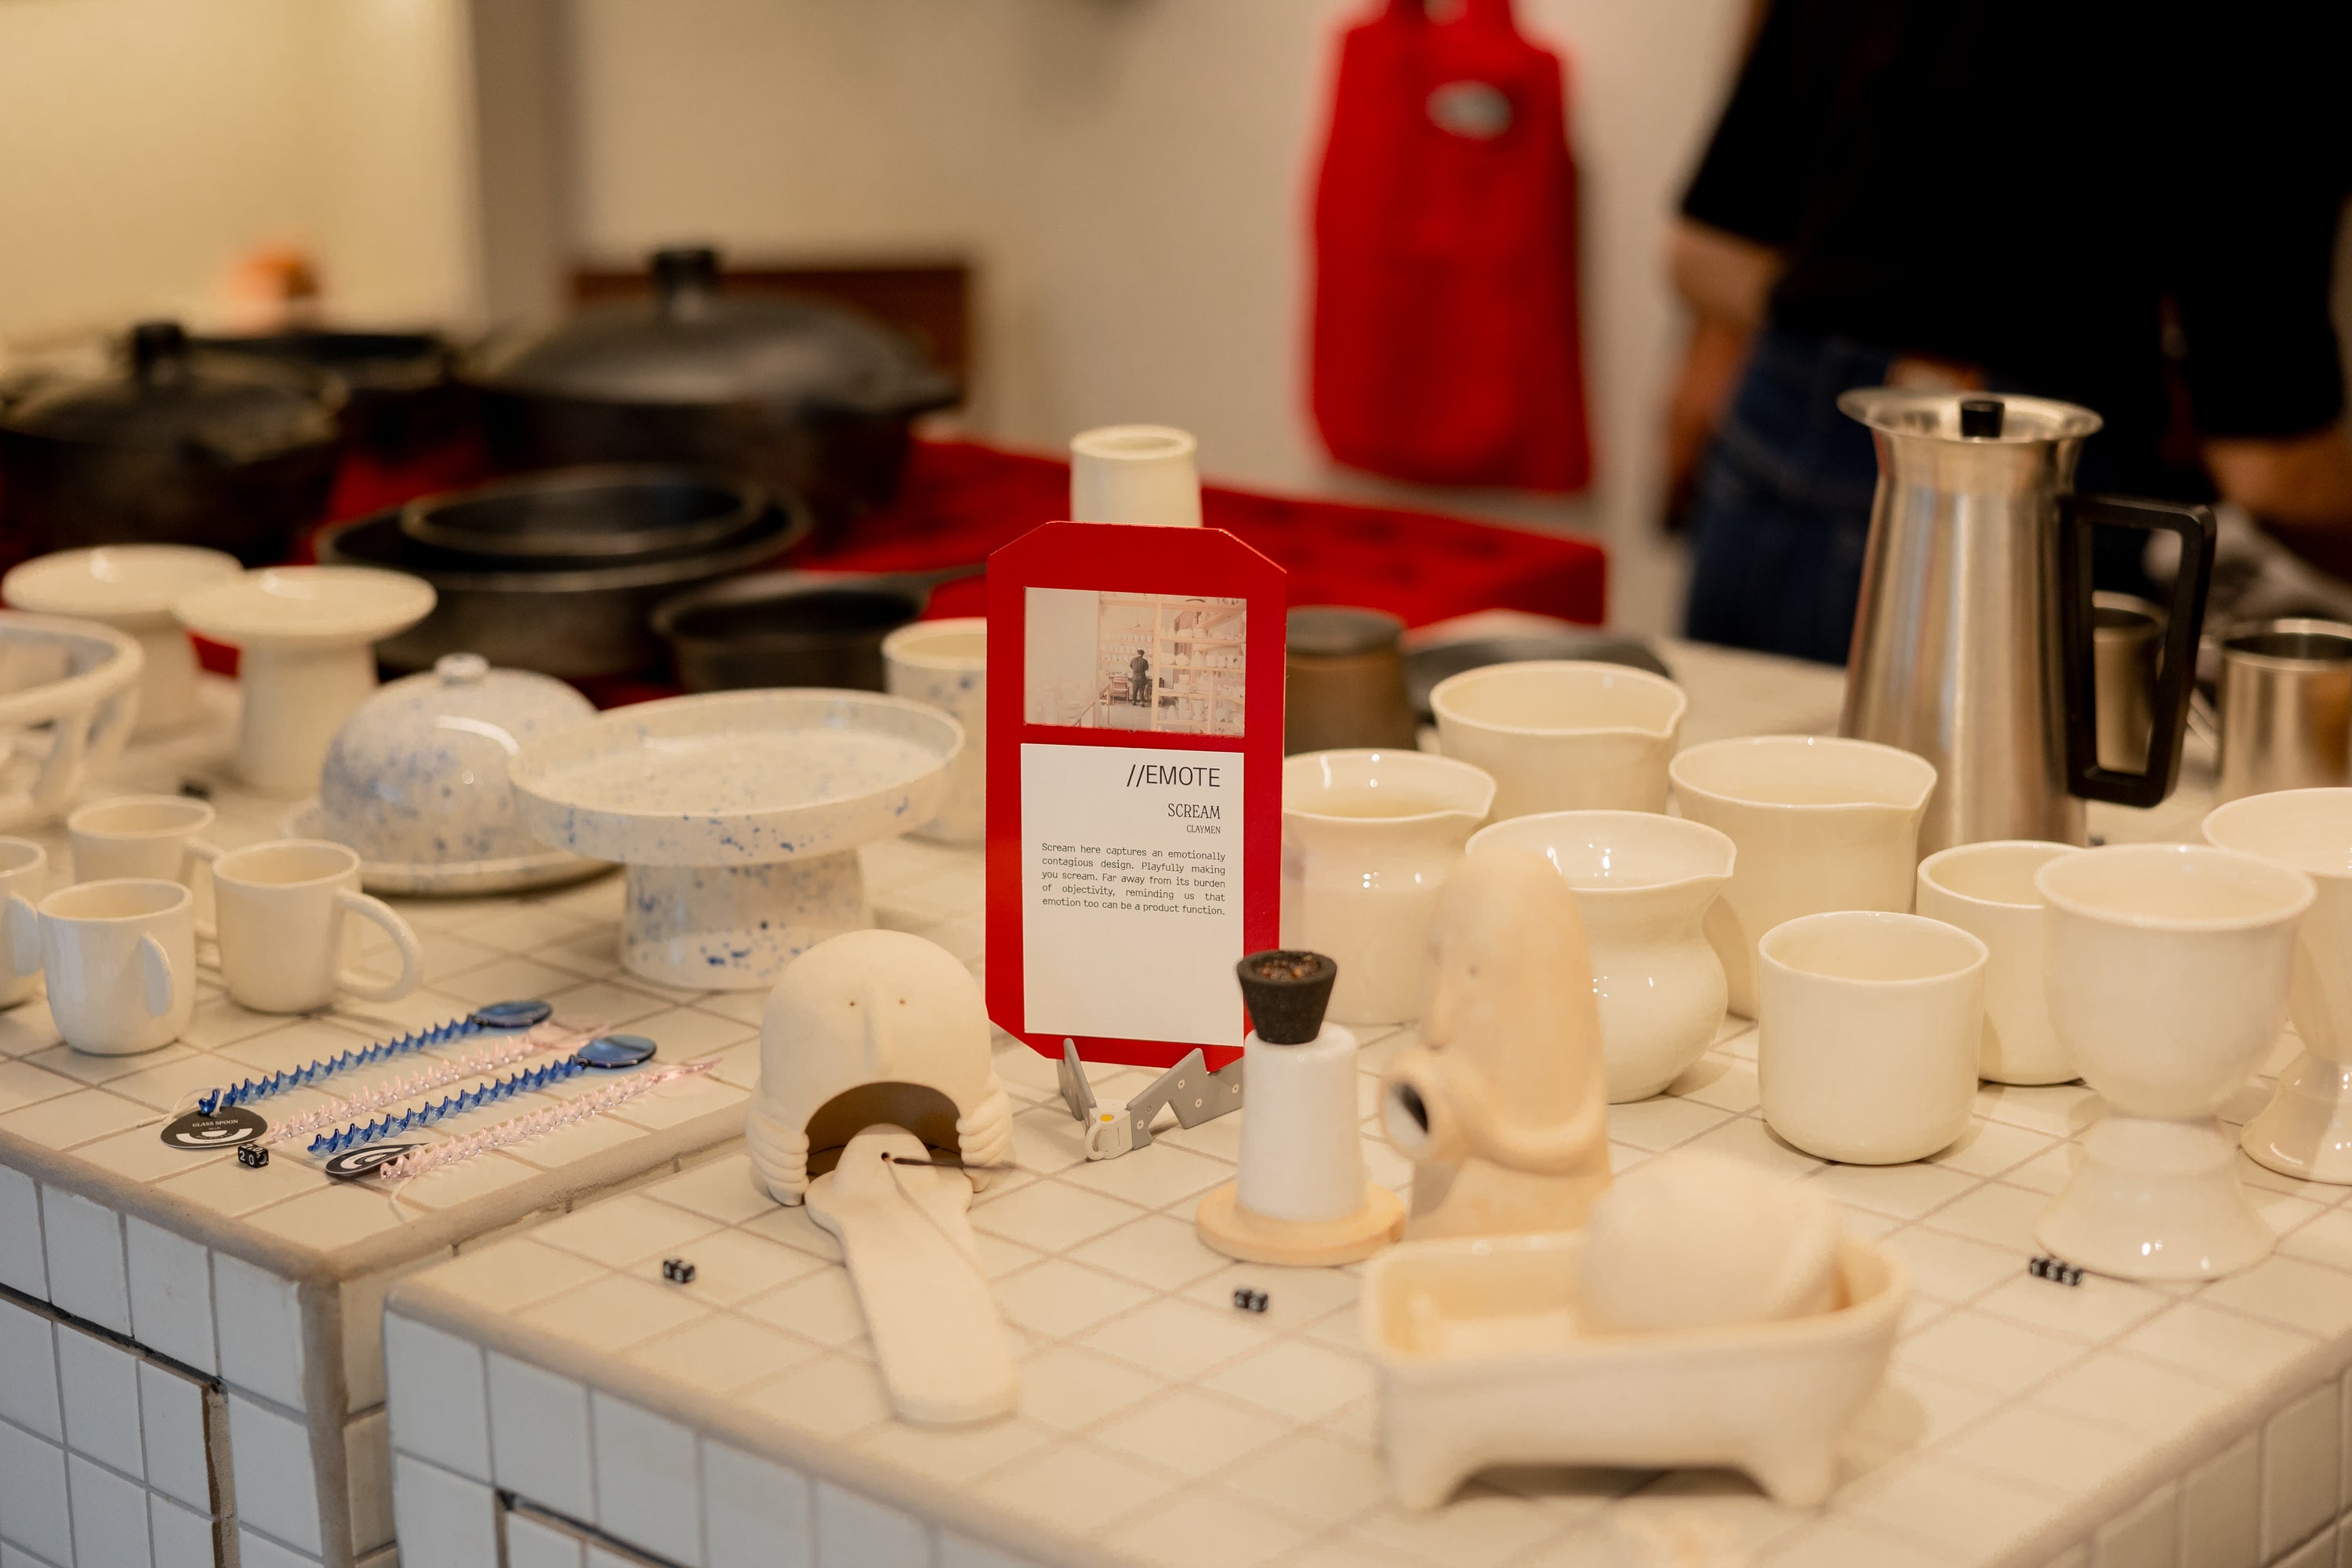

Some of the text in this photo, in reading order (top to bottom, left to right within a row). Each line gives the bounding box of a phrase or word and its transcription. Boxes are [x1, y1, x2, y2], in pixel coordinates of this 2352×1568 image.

[1167, 803, 1221, 819] SCREAM
[1186, 824, 1221, 834] CLAYMEN
[1042, 843, 1075, 852] Scream
[1081, 845, 1101, 854] here
[1106, 847, 1147, 857] captures
[1168, 850, 1225, 862] emotionally
[1042, 858, 1225, 876] contagious design. Playfully making
[1102, 873, 1117, 882] Far
[1121, 875, 1145, 885] away
[1176, 877, 1189, 886] its
[1194, 879, 1225, 887] burden
[1062, 884, 1115, 897] objectivity,
[1126, 888, 1174, 901] reminding
[1205, 893, 1225, 902] that
[1043, 898, 1081, 906] emotion
[1083, 899, 1099, 908] too
[1183, 906, 1225, 915] function.
[239, 1150, 255, 1166] 20
